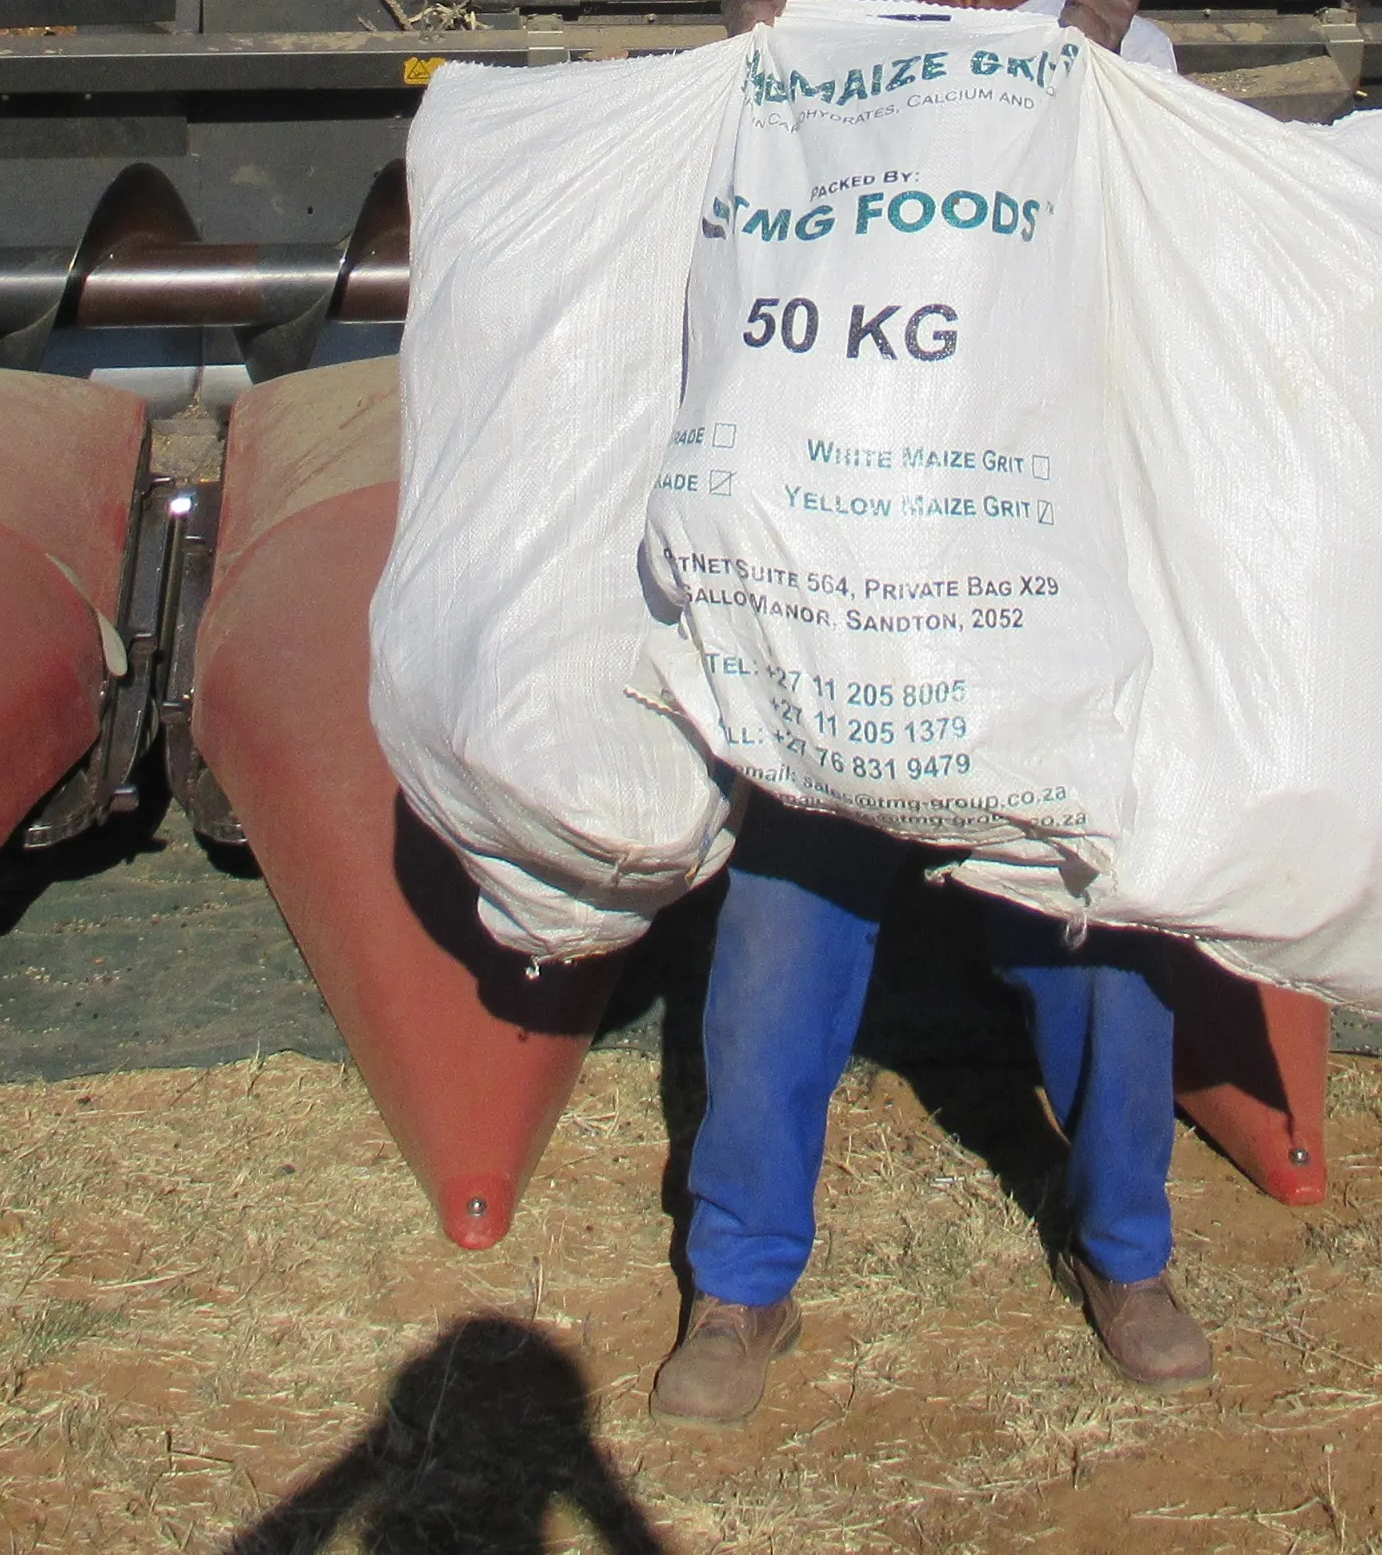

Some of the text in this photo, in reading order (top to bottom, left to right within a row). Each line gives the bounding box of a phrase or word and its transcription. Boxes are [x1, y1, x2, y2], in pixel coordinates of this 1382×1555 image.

[906, 87, 993, 108] CALCIUM
[999, 91, 1035, 110] AND
[809, 175, 876, 202] PACKED
[854, 189, 1041, 243] FOODS
[742, 297, 959, 362] 50 KG
[982, 449, 1025, 474] GRIT
[783, 484, 892, 517] YELLOW
[983, 495, 1031, 519] GRIT
[806, 573, 856, 601] 564,
[864, 578, 960, 601] PRIVATE
[967, 575, 1013, 597] BAG
[1019, 575, 1060, 596] X29
[846, 609, 964, 633] SANDTON,
[971, 608, 1024, 629] 2052
[766, 663, 802, 693] +27
[813, 674, 836, 702] 11
[846, 681, 894, 708] 205
[903, 678, 967, 708] 8005
[770, 696, 967, 745] +27 11 205 1379
[816, 746, 845, 774] 76
[852, 755, 897, 781] 831
[906, 752, 972, 780] 9479
